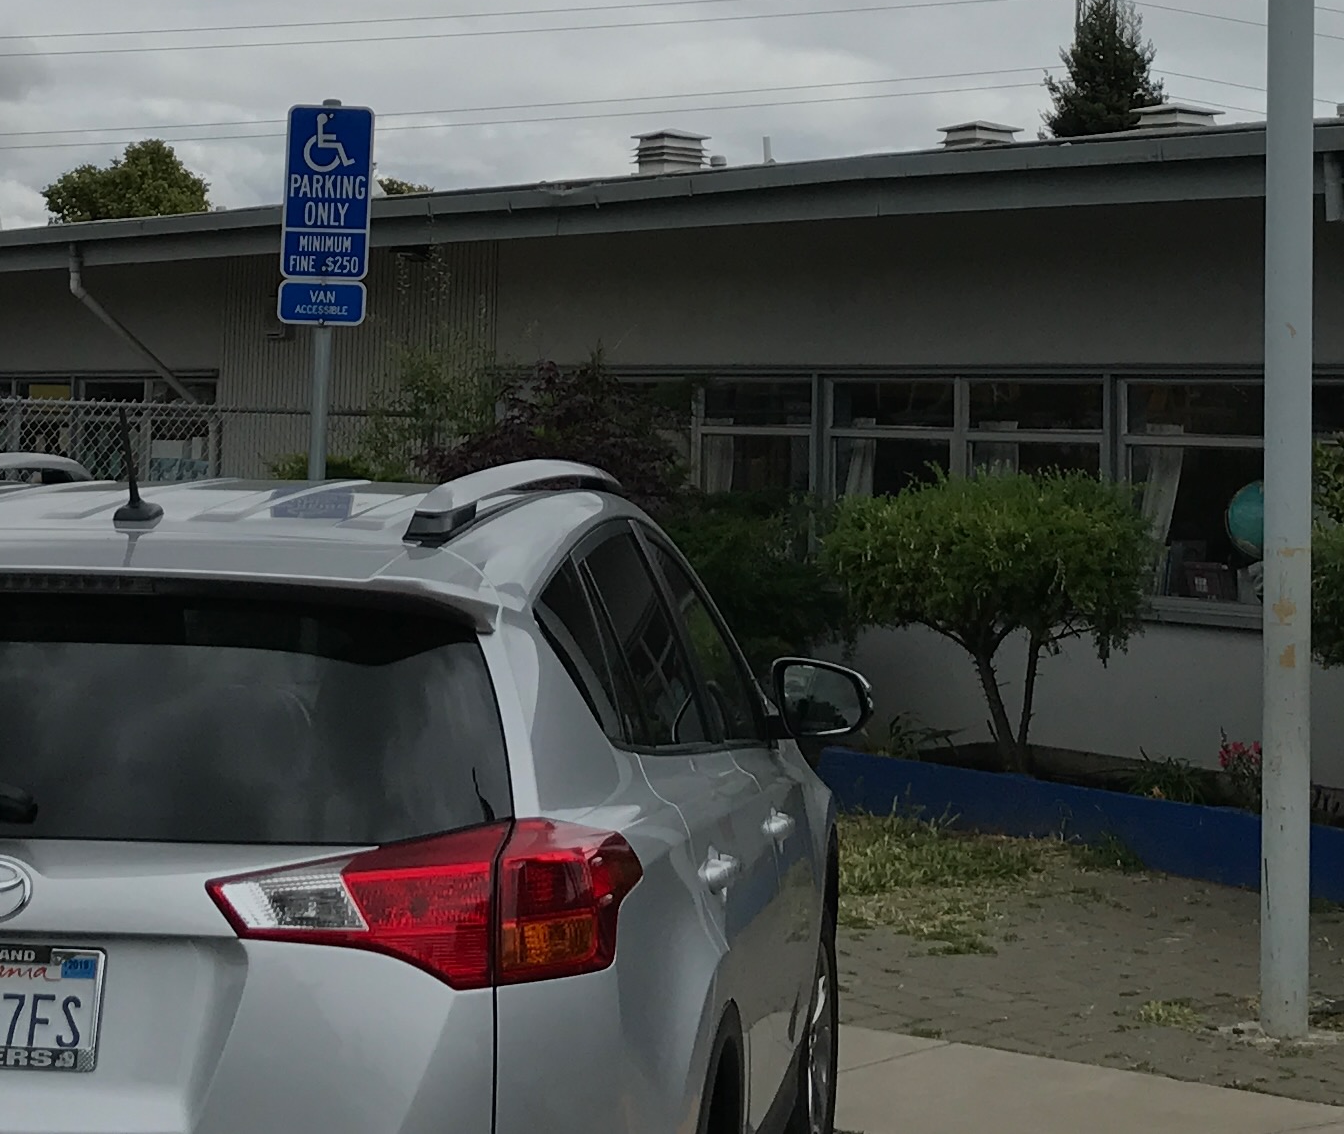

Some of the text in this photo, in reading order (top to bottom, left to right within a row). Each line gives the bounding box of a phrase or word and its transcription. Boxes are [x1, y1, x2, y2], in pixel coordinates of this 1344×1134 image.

[290, 174, 366, 199] PARKING
[304, 202, 349, 226] ONLY
[299, 236, 352, 253] MINIMUM
[290, 256, 359, 273] FINE $250
[309, 289, 336, 304] VAN
[294, 304, 348, 315] ACCESSIBLE
